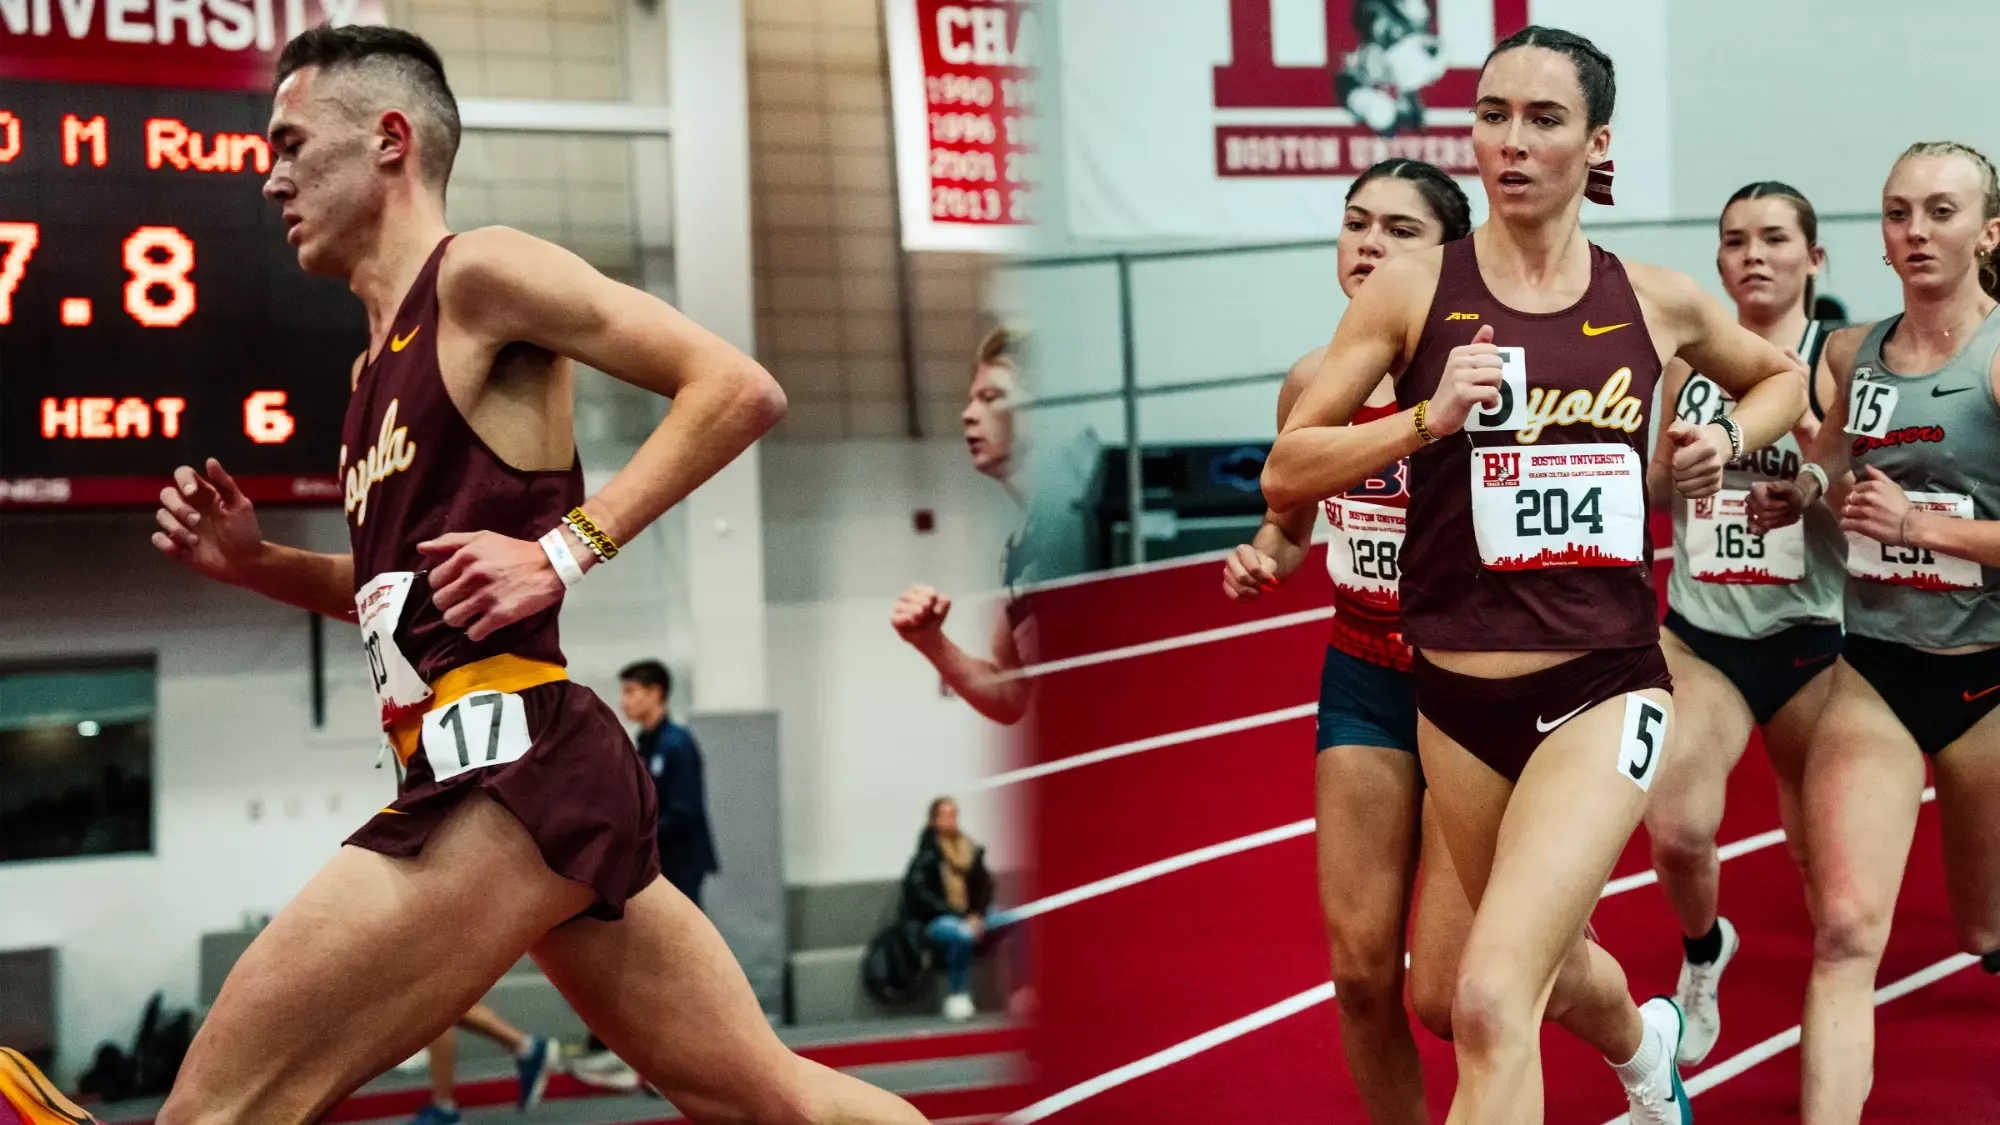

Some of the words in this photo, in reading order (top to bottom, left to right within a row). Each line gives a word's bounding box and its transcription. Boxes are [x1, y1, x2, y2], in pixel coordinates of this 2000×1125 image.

[61, 113, 107, 169] M
[146, 118, 271, 173] Run
[1226, 136, 1339, 169] BOSTON
[41, 397, 187, 439] HEAT
[243, 390, 295, 444] 6
[1853, 384, 1890, 432] 15
[339, 398, 416, 526] oyola
[1483, 452, 1521, 482] BU
[1531, 455, 1567, 467] BOSTON
[1570, 453, 1625, 465] UNIVERSITY
[1515, 487, 1604, 537] 204
[1348, 537, 1398, 581] 128
[1714, 523, 1765, 558] 163
[439, 692, 503, 768] 17
[1627, 703, 1664, 781] 5
